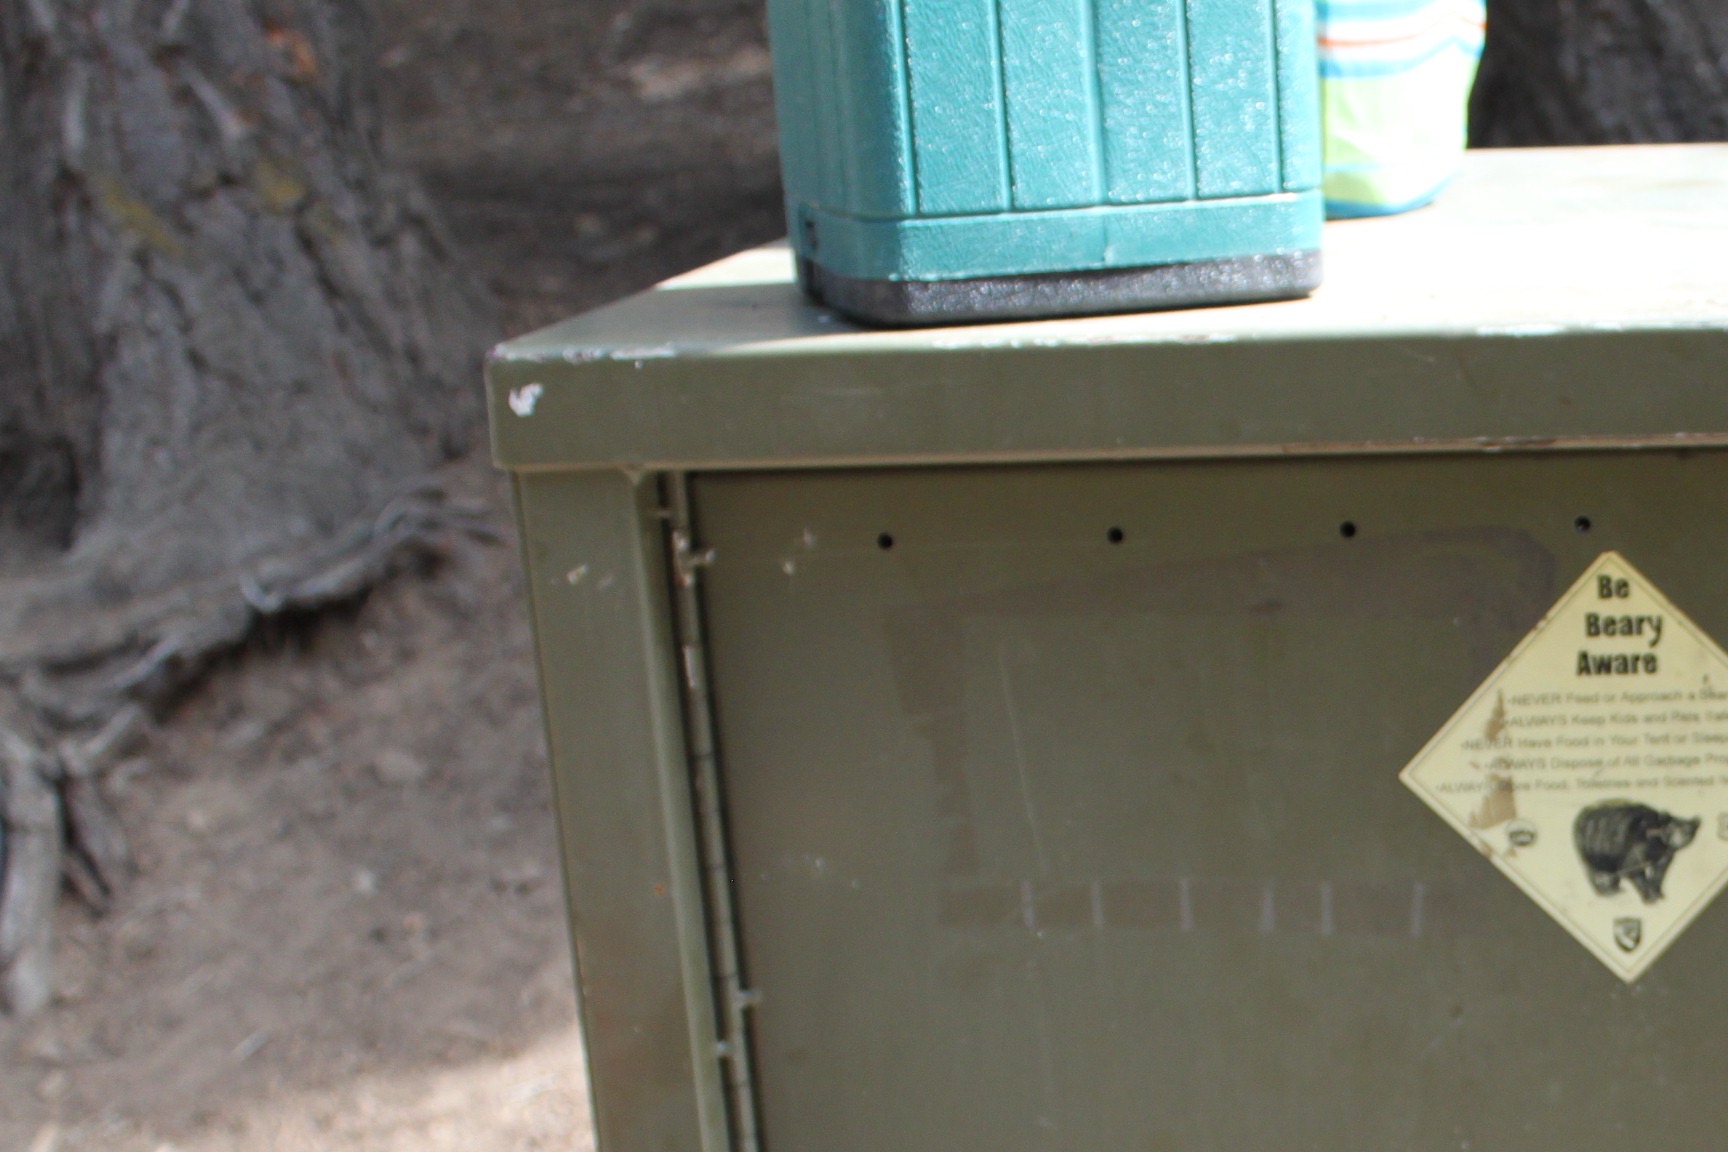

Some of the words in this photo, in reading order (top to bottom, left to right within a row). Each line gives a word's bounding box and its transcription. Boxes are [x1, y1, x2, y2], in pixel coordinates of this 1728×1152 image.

[1597, 575, 1630, 600] Be
[1586, 612, 1664, 648] Beary
[1576, 651, 1658, 676] Aware
